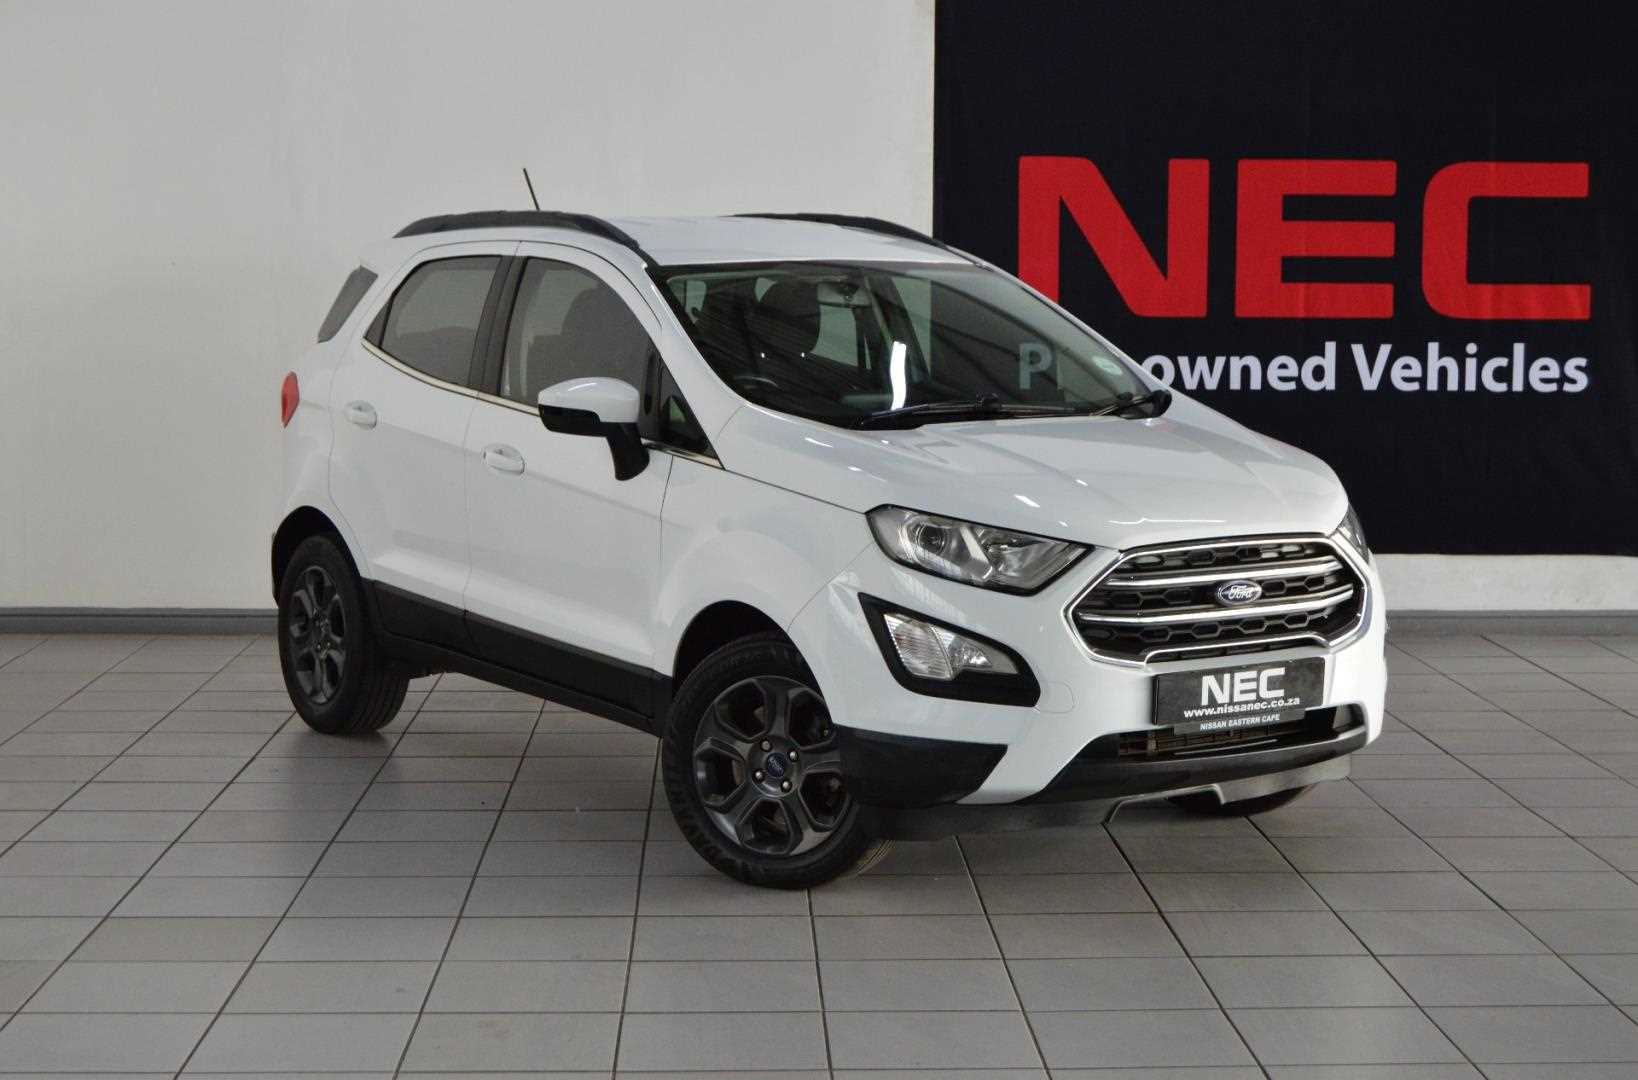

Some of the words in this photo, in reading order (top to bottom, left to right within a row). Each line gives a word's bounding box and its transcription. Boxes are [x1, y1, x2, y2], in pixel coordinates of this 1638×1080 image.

[1018, 155, 1591, 320] NEC
[1351, 341, 1589, 394] Vehicles
[1201, 667, 1286, 706] NEC
[1183, 697, 1300, 718] www.nissanec.co.za
[1200, 721, 1227, 731] NISSAN
[1228, 717, 1260, 727] EASTERN
[1261, 714, 1281, 723] CAPE
